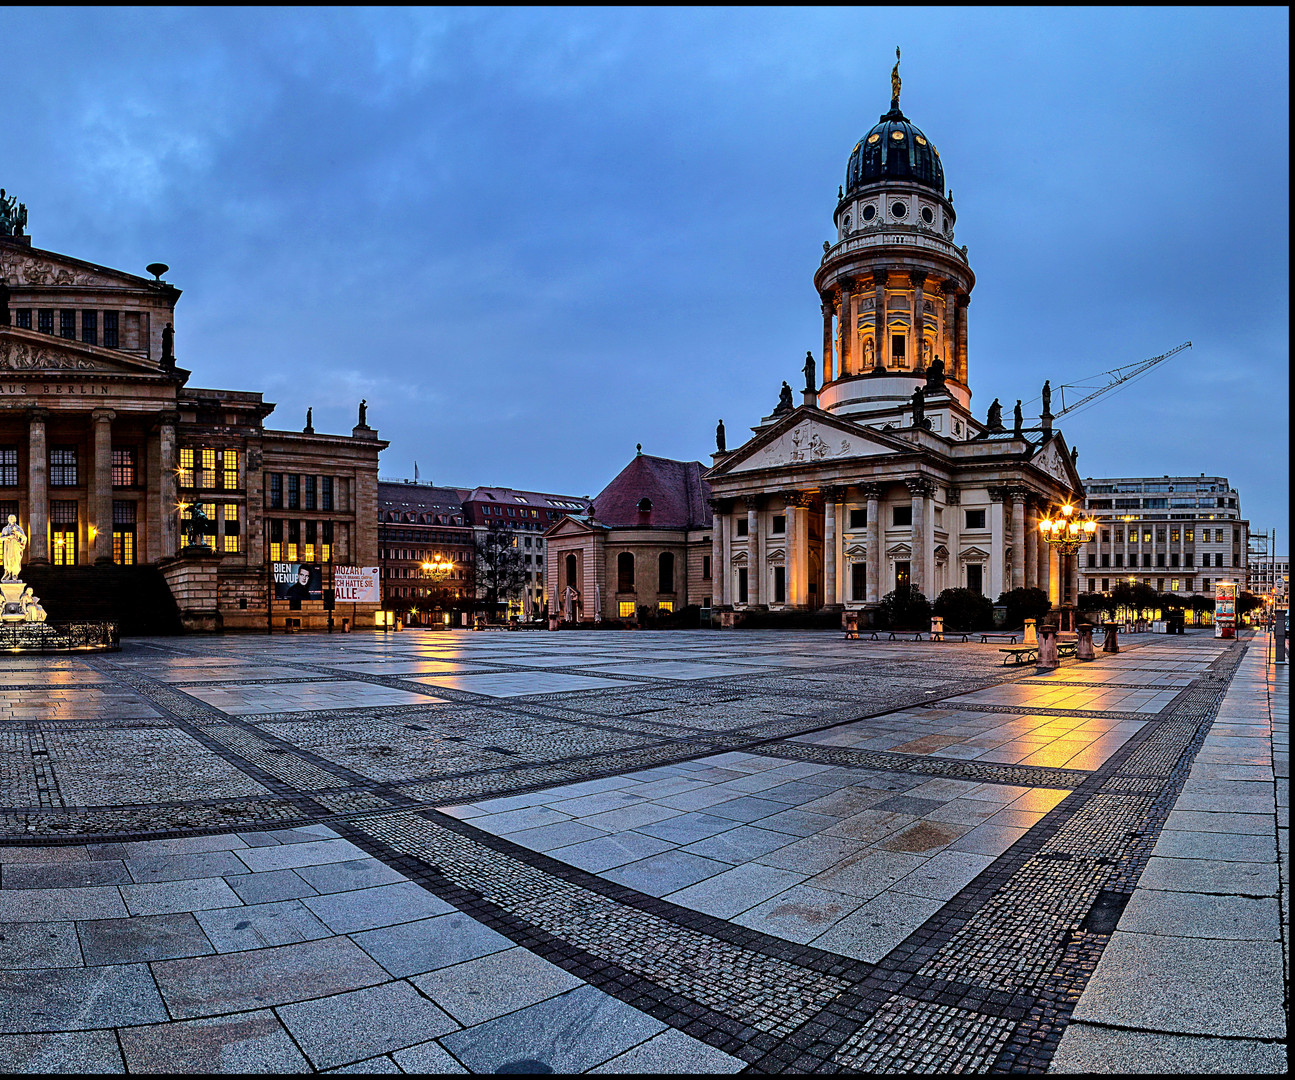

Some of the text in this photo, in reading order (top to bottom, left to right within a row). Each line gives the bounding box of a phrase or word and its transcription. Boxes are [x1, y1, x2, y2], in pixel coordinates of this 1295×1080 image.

[43, 385, 109, 395] BERLIN
[273, 563, 292, 573] BIEN
[273, 573, 299, 583] VENUE
[346, 580, 364, 588] HATTE
[365, 580, 374, 588] SIE
[334, 587, 361, 600] ALLE.
